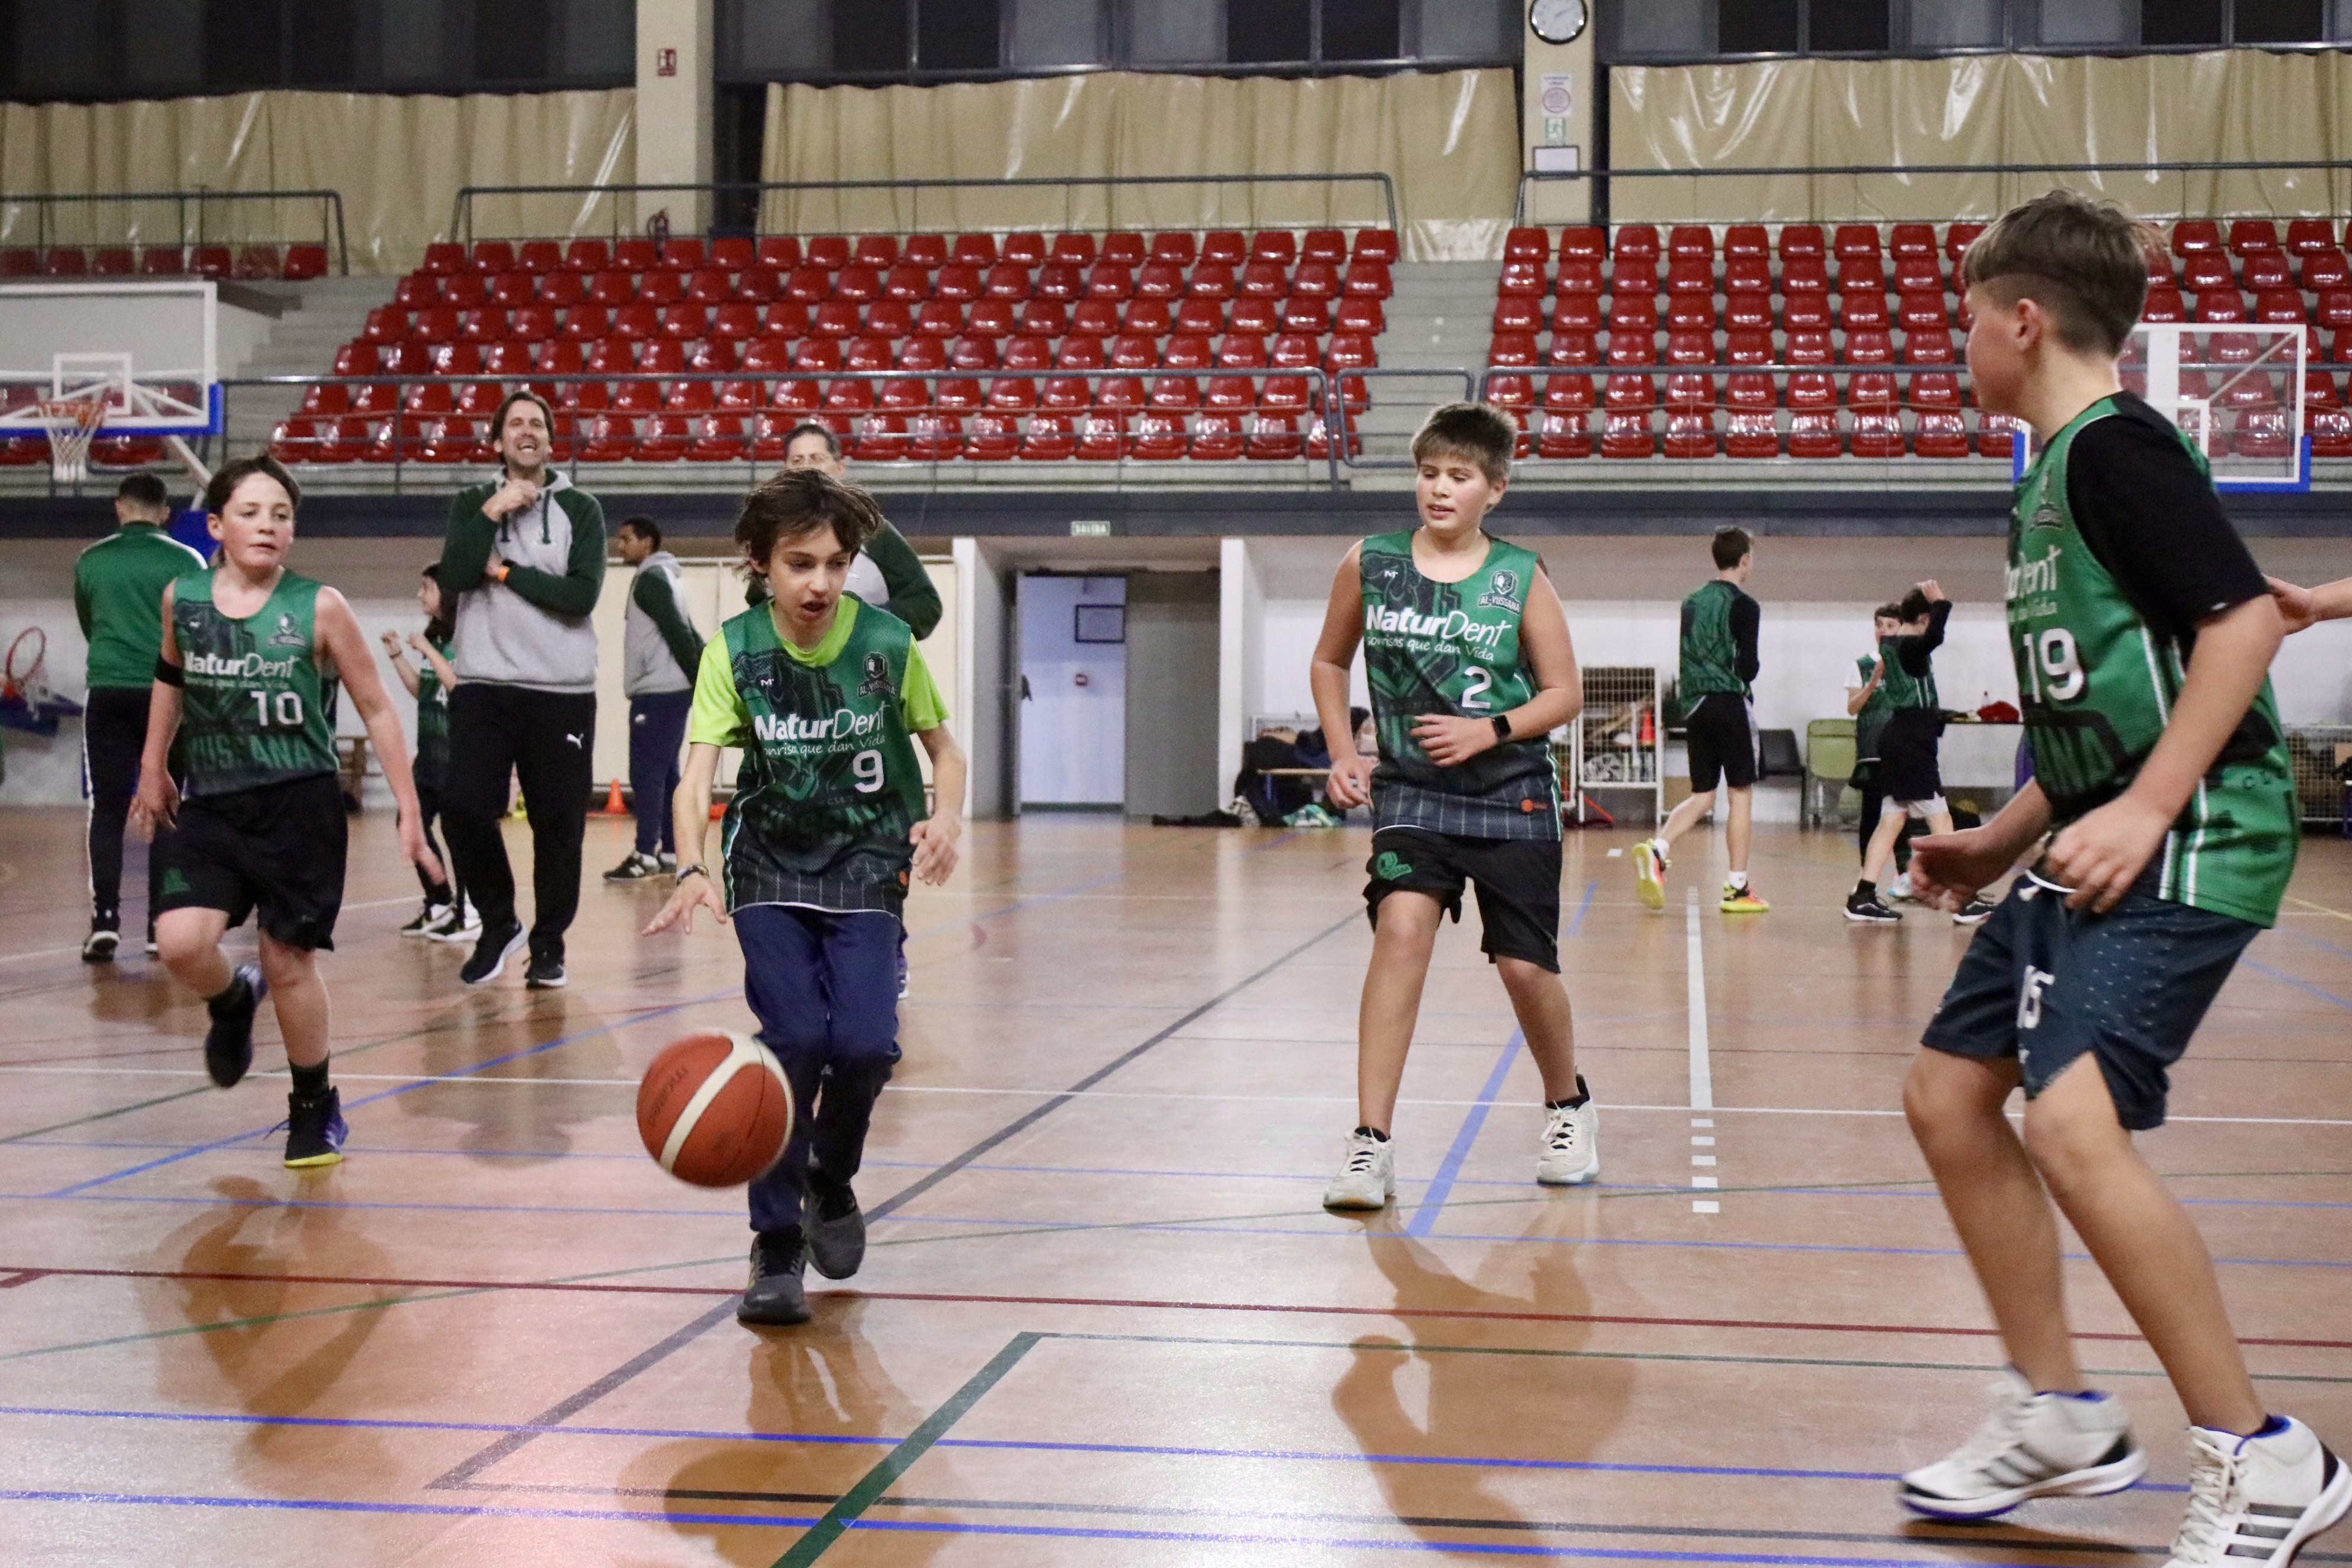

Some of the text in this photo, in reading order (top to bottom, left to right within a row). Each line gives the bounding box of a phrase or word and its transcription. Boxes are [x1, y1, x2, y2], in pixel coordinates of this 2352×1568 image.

[1366, 604, 1512, 647] NaturDent
[1407, 639, 1430, 653] que
[1434, 640, 1461, 654] dan
[1466, 646, 1494, 661] Vida
[2023, 628, 2085, 703] 19
[1462, 666, 1492, 708] 2
[250, 691, 304, 727] 10
[754, 701, 890, 741] NaturDent
[801, 744, 823, 759] que
[828, 741, 854, 752] dan
[860, 734, 886, 748] Vida
[853, 749, 884, 793] 9
